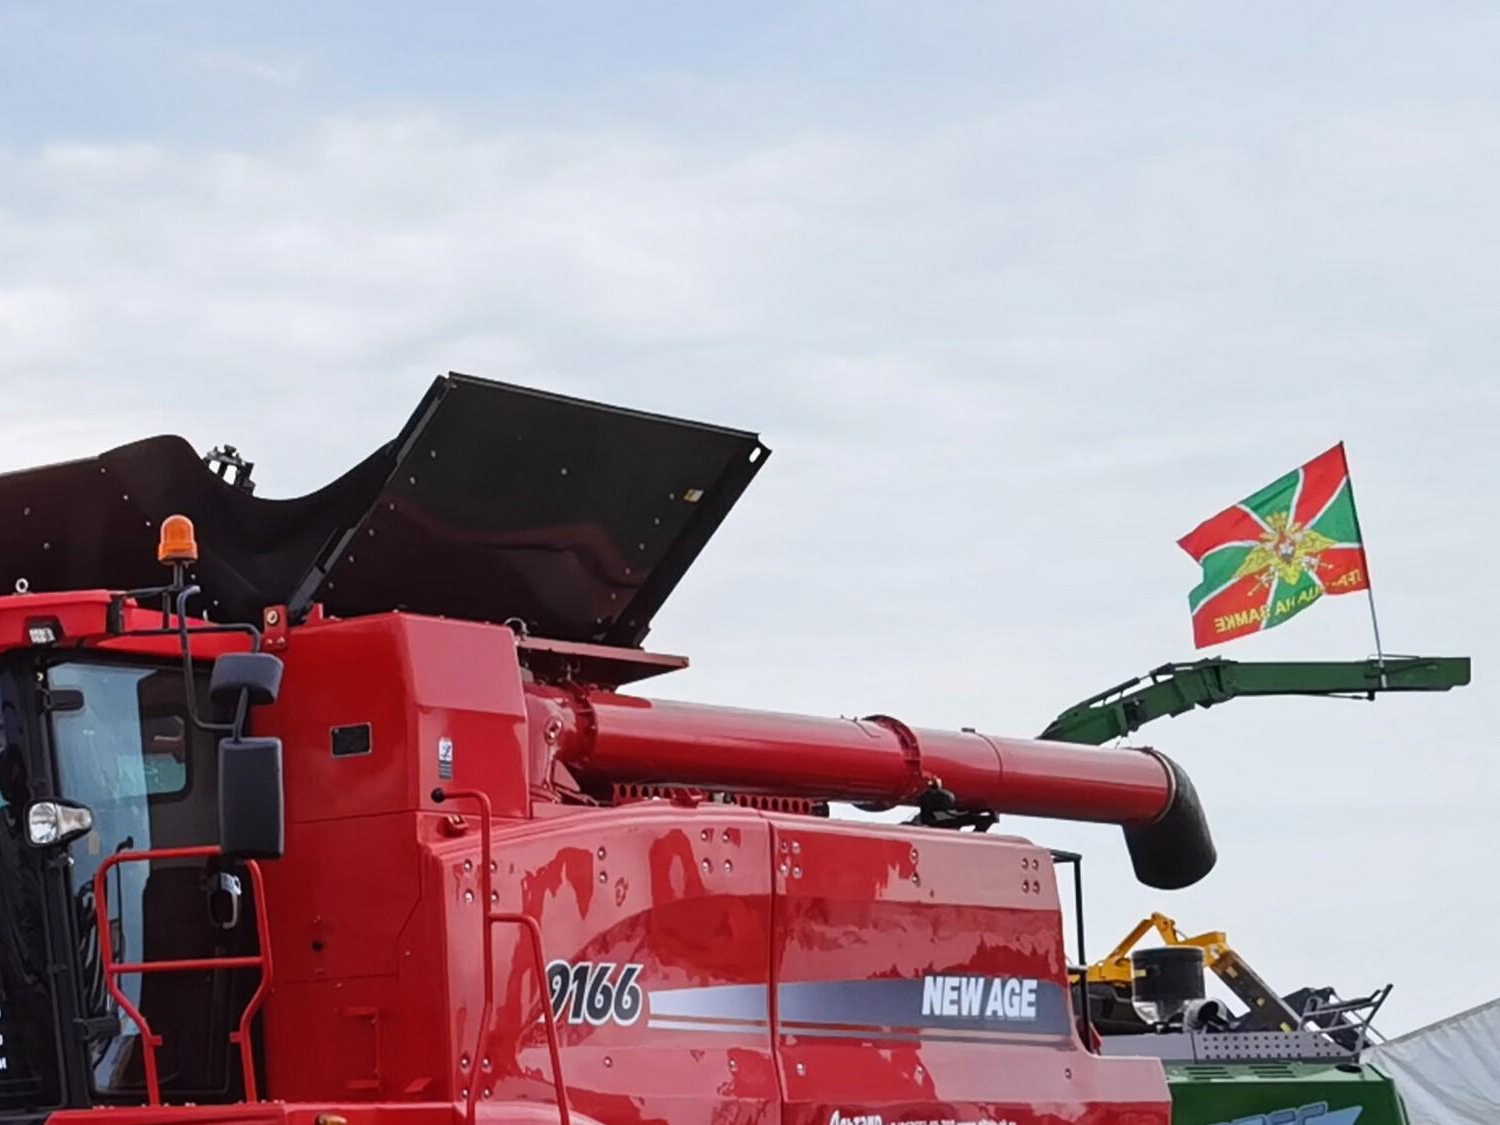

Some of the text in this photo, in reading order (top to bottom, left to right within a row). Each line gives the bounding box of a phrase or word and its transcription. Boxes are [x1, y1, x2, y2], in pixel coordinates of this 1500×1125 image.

[538, 959, 644, 1026] 9166
[921, 975, 1038, 1018] NEW AGE
